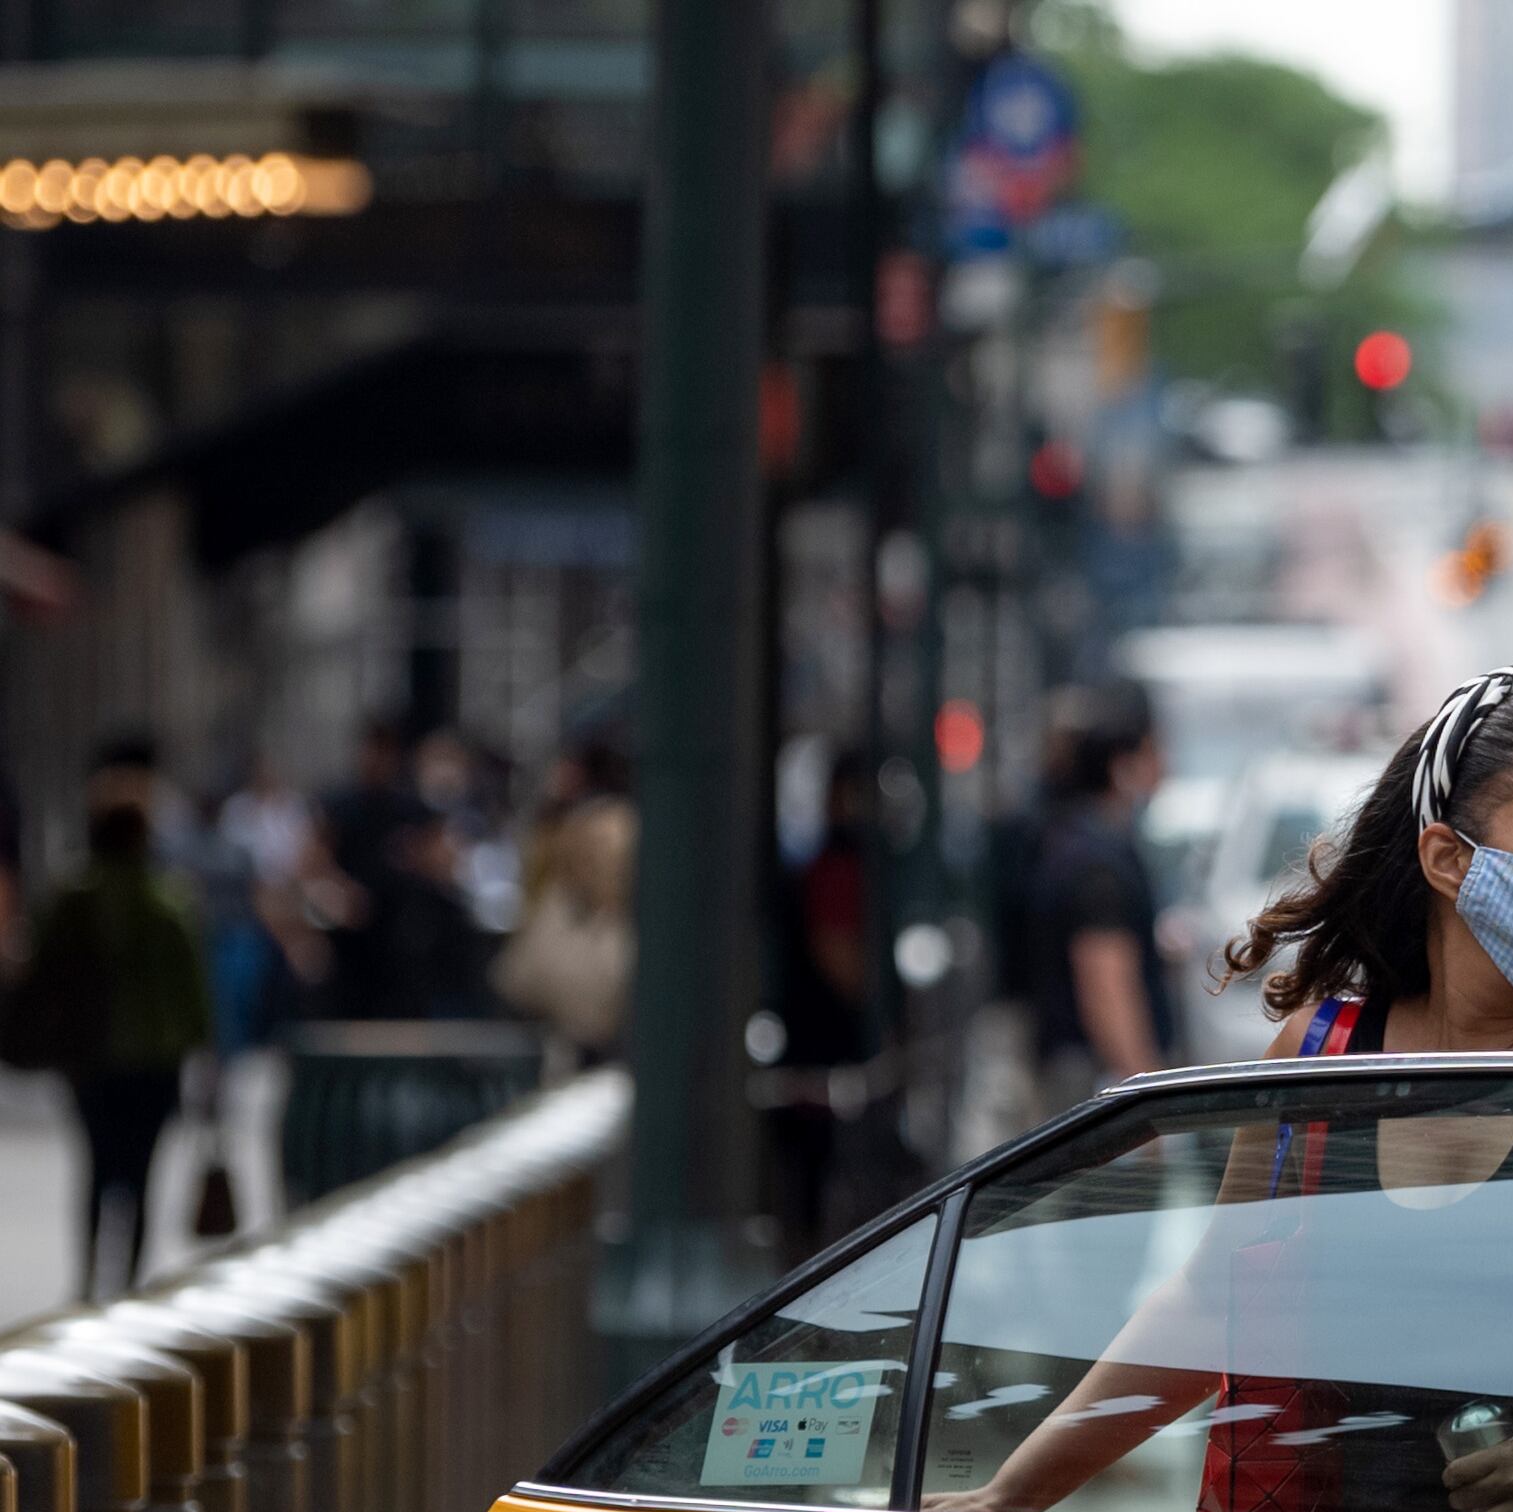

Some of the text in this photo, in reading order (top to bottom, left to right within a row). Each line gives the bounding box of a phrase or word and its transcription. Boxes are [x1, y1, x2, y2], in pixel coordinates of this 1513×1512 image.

[727, 1371, 866, 1410] ARRO
[759, 1420, 789, 1433] VISA
[808, 1418, 828, 1433] Pay
[744, 1465, 820, 1478] GoArro.com
